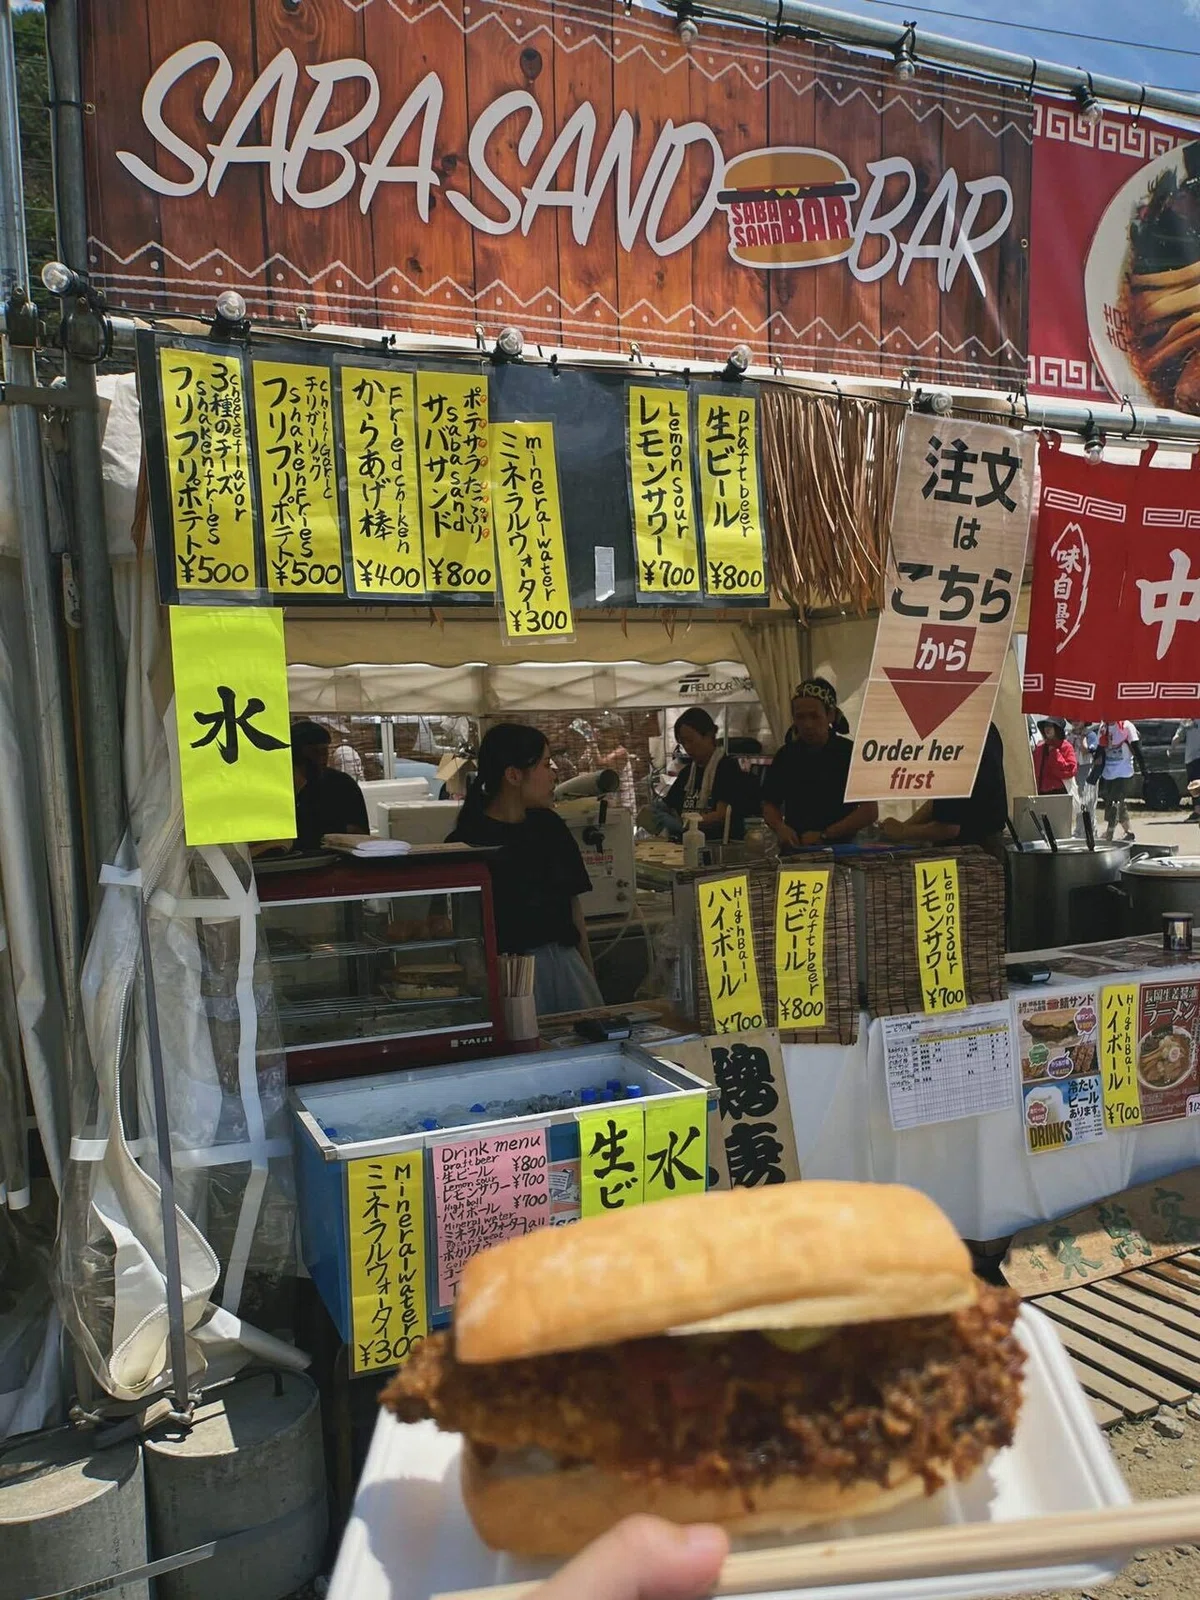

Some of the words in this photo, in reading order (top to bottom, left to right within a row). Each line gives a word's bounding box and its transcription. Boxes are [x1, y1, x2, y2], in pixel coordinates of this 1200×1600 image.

[115, 39, 444, 223] SABA
[447, 88, 733, 257] SAND
[848, 156, 1014, 298] BAR
[730, 200, 779, 225] SABA
[779, 196, 850, 244] BAR
[734, 223, 783, 247] SAND
[210, 363, 234, 494] 3種のチーズ
[304, 376, 320, 482] チリガーリック
[170, 366, 203, 555] フリフリポテト
[262, 377, 295, 562] フリフリポテト
[352, 378, 395, 541] からあげ棒
[422, 394, 452, 538] サバサンド
[462, 386, 484, 544] ポテサラたっぷり
[636, 394, 668, 555] レモンサワー
[705, 405, 740, 528] 生ビール
[921, 434, 1022, 512] 注文
[500, 430, 537, 610] ミネラルウォーター
[953, 516, 980, 551] は
[178, 554, 249, 583] ¥500
[272, 559, 342, 586] ¥500
[356, 559, 420, 588] ¥400
[428, 557, 491, 587] ¥800
[642, 560, 694, 588] ¥700
[709, 561, 762, 590] ¥800
[891, 562, 1012, 624] こちら
[1136, 548, 1200, 661] 中
[509, 610, 568, 632] ¥300
[916, 637, 967, 672] から
[190, 685, 291, 764] 水
[862, 738, 924, 762] Order
[928, 738, 964, 762] her
[890, 766, 934, 790] first
[784, 880, 810, 972] 生ビール
[920, 868, 944, 985] レモンサワー
[708, 888, 741, 1000] ハイボール
[779, 997, 824, 1020] ¥800
[926, 987, 964, 1009] ¥700
[1144, 1000, 1197, 1026] ラーメン
[1106, 993, 1124, 1091] ハイボール
[1068, 1079, 1099, 1093] 冷たい
[1069, 1092, 1100, 1108] ビール
[1105, 1100, 1140, 1124] ¥700
[1029, 1120, 1072, 1148] DRINKS
[442, 1141, 490, 1163] Drink
[494, 1136, 540, 1152] menu
[512, 1155, 546, 1172] ¥800
[588, 1120, 638, 1208] 生ビ
[647, 1126, 704, 1190] 水
[442, 1166, 494, 1184] 生ビール
[512, 1174, 545, 1188] ¥700
[443, 1182, 511, 1203] レモンサワー
[513, 1194, 548, 1208] ¥700
[443, 1203, 500, 1222] ハイボール
[444, 1218, 524, 1242] ミネラルウォーター
[363, 1164, 394, 1338] ミネラルウォーター
